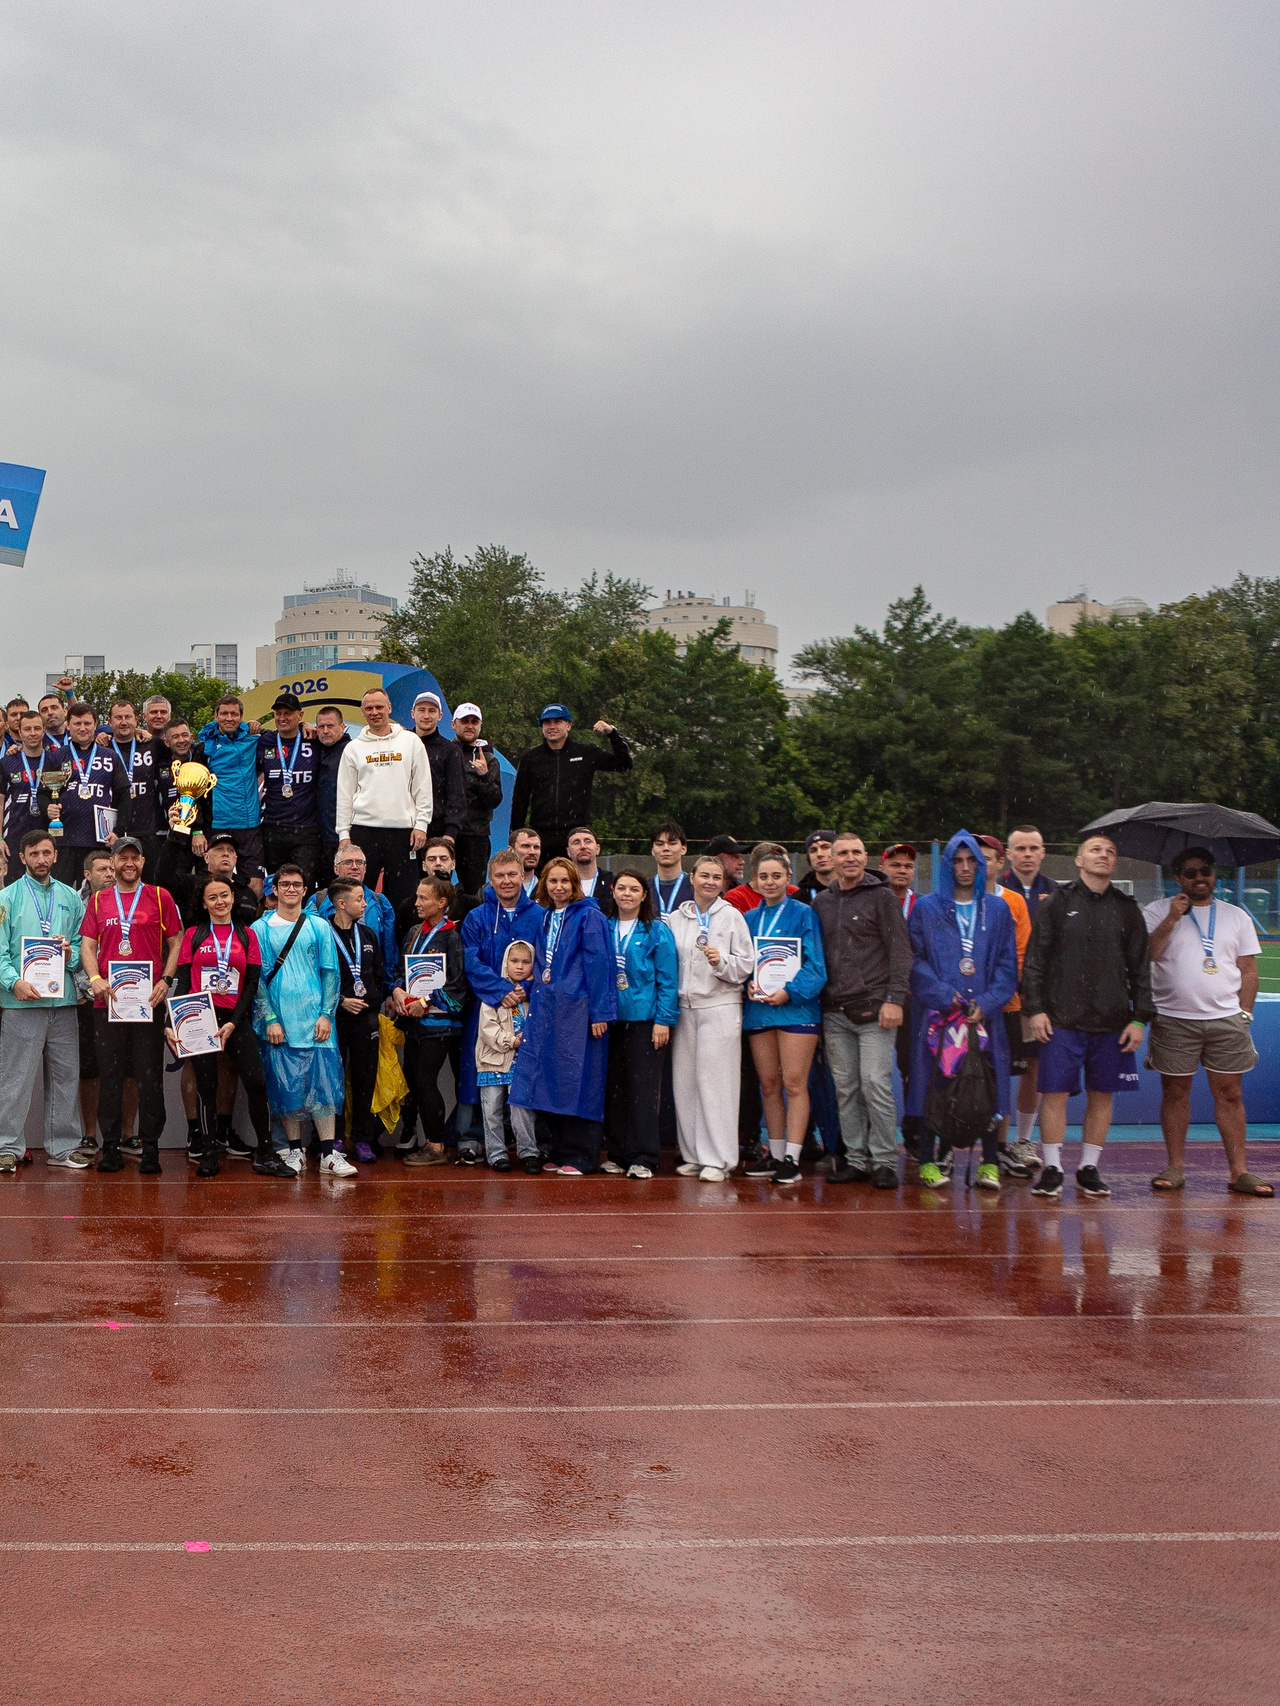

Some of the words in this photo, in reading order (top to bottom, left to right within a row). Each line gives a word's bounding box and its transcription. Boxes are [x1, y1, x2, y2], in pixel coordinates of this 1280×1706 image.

[279, 677, 329, 696] 2026
[301, 742, 313, 758] 5
[91, 756, 114, 773] 55
[133, 751, 153, 767] 36
[132, 782, 147, 795] ТБ
[106, 917, 118, 927] РГС
